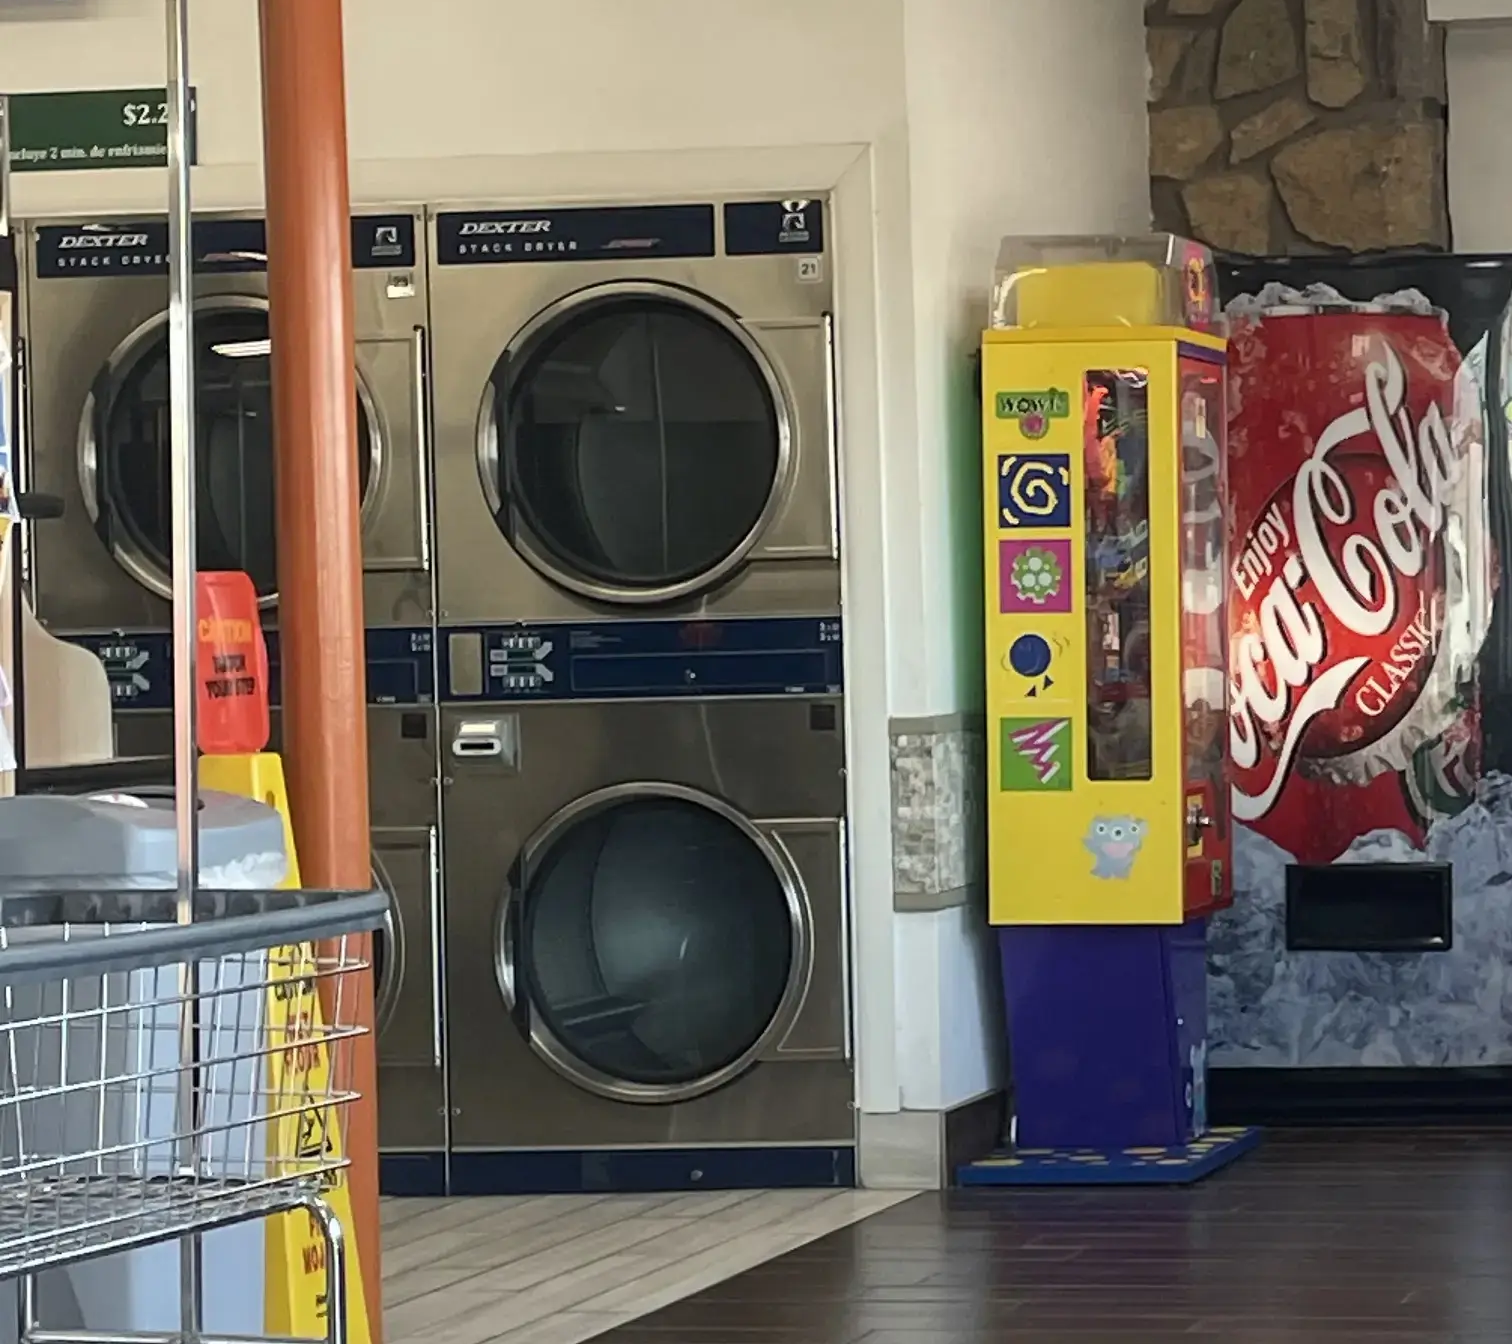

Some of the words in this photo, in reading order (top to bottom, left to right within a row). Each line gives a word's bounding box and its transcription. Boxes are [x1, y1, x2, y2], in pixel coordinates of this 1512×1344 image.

[123, 102, 170, 127] $2.2
[107, 143, 168, 157] enfriamie
[459, 219, 551, 236] DEXTER
[58, 233, 148, 249] DEXTER
[459, 242, 513, 255] STACK
[57, 255, 111, 268] STACK
[801, 262, 816, 276] 21
[1231, 500, 1290, 601] Enjoy
[1231, 338, 1460, 821] oca-Cola
